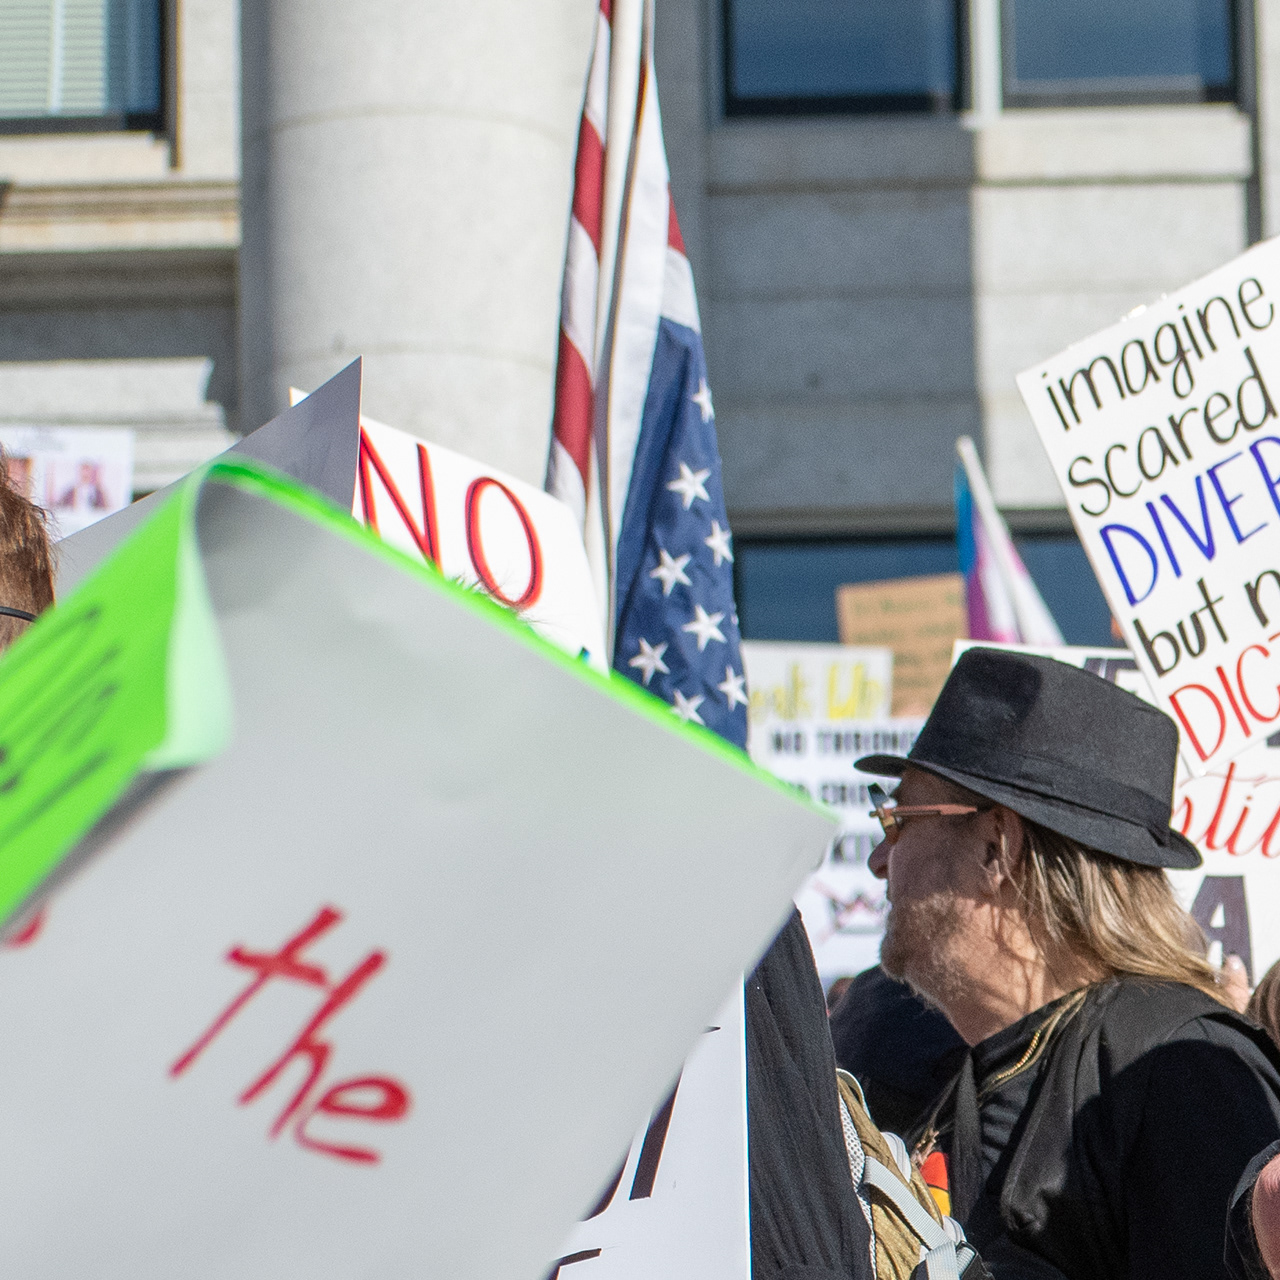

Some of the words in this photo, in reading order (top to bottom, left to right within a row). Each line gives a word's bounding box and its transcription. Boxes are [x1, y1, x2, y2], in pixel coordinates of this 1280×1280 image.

[1042, 276, 1275, 432] imagine
[1068, 347, 1278, 517] scared
[357, 425, 544, 612] NO
[1133, 578, 1225, 677] but
[170, 904, 412, 1165] the
